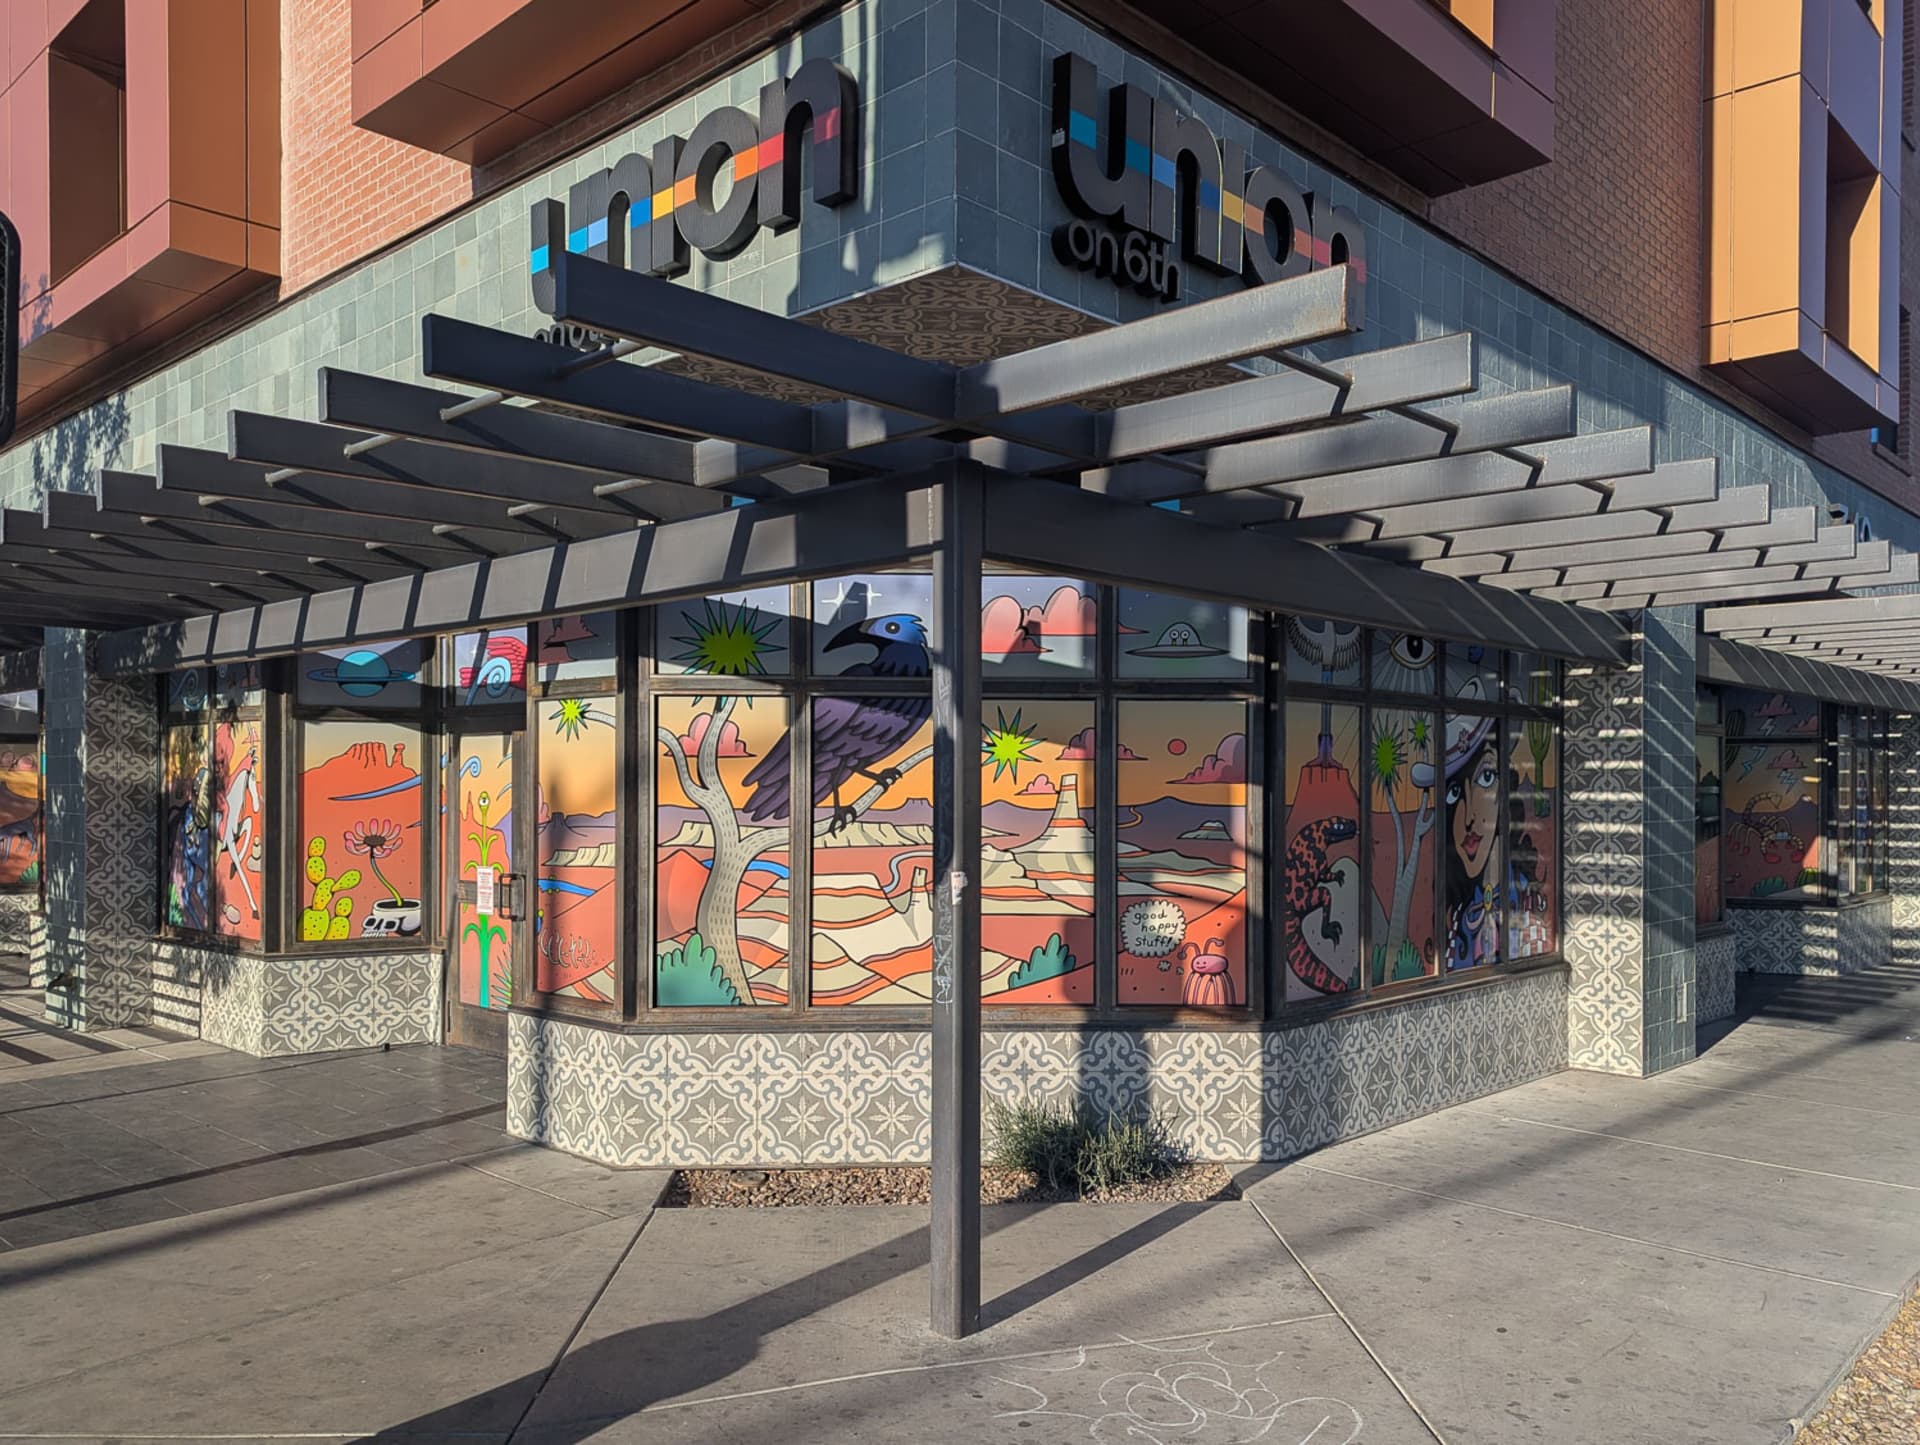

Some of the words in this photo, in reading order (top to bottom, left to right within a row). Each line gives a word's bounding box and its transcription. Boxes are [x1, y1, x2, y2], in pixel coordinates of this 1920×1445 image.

[531, 57, 858, 320] union
[1052, 52, 1366, 331] union
[1133, 909, 1167, 925] good
[1141, 922, 1178, 934] happy
